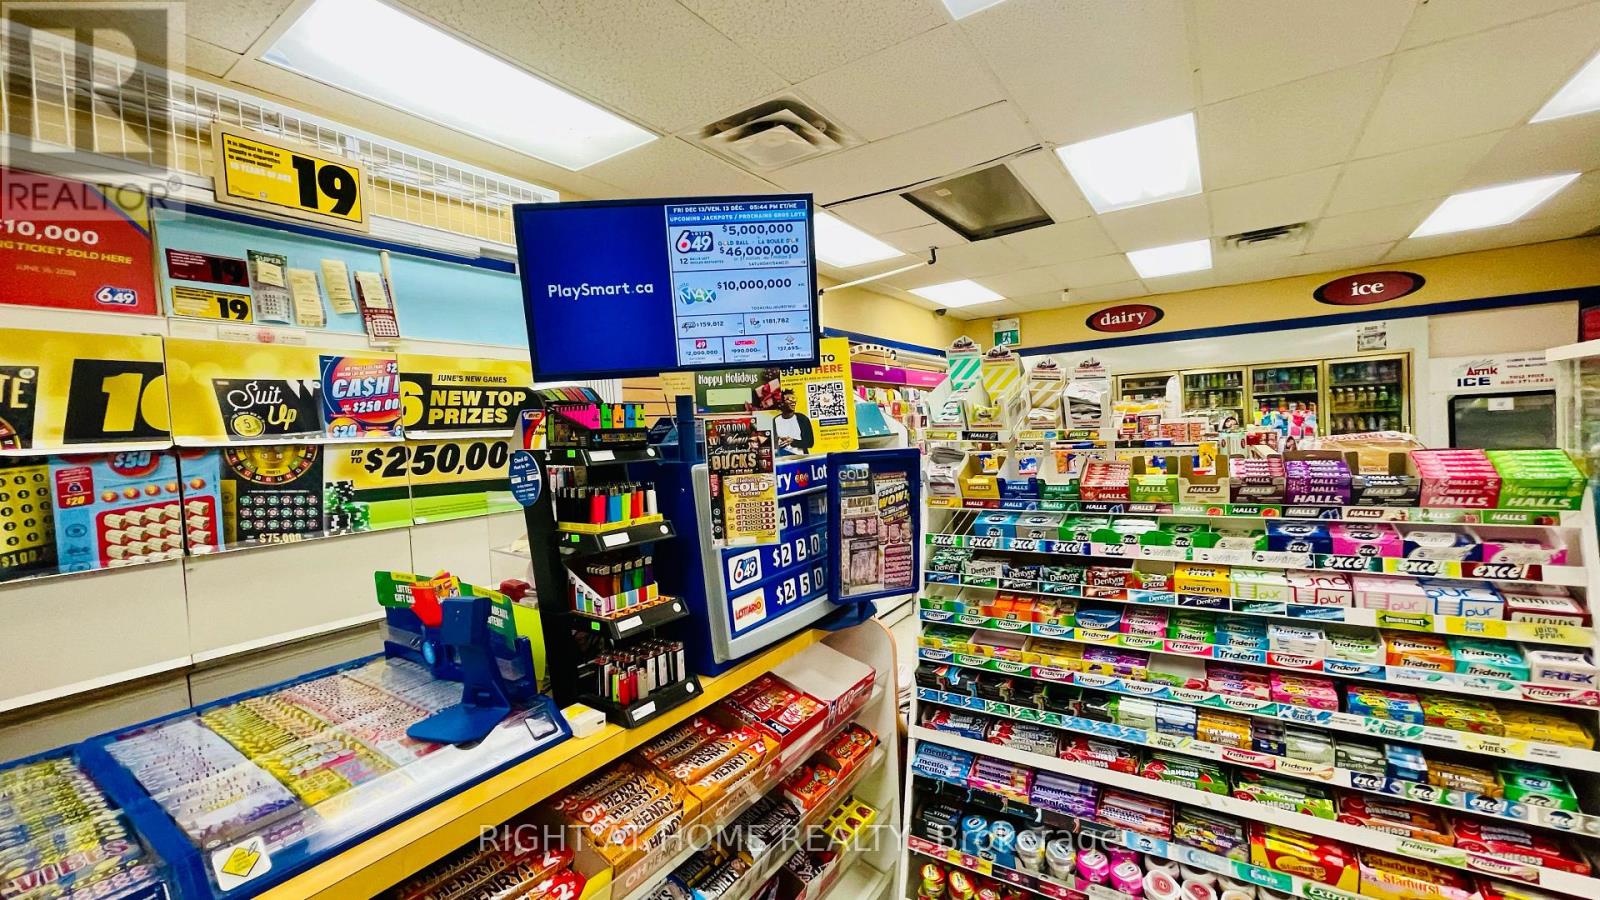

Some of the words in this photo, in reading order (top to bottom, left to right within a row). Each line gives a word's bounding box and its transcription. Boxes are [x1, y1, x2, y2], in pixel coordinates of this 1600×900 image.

[292, 154, 357, 216] 19
[722, 223, 793, 236] $5,000,000
[16, 242, 67, 256] TICKET
[66, 248, 99, 260] SOLD
[101, 252, 133, 265] HERE
[720, 244, 799, 257] $46,000,000
[680, 257, 689, 265] 12
[547, 281, 654, 300] PlaySmart.ca
[717, 278, 792, 291] $10,000,000
[1351, 279, 1384, 297] ice
[217, 297, 249, 321] 19
[1100, 308, 1147, 328] dairy
[696, 340, 707, 349] 49
[821, 354, 835, 363] TO
[815, 363, 844, 375] HERE
[437, 374, 463, 383] JUNE'S
[464, 375, 482, 383] NEW
[698, 374, 723, 388] Happy
[725, 372, 759, 386] Holidays
[1457, 376, 1491, 387] ICE
[331, 375, 388, 400] CA$H
[227, 380, 282, 411] Suit
[429, 390, 485, 406] NEW
[485, 391, 526, 406] TOP
[267, 405, 298, 431] Up
[428, 408, 508, 425] PRIZES
[351, 449, 363, 457] UP
[712, 453, 757, 470] BUCKS
[839, 468, 869, 480] GOLD
[729, 482, 769, 493] GOLD
[66, 495, 85, 505] $20
[879, 491, 909, 509] WOW!
[1293, 495, 1344, 504] HALLS
[1427, 496, 1489, 507] HALLS
[1506, 497, 1572, 509] HALLS
[1350, 509, 1381, 517] HALLS
[1491, 513, 1527, 521] HALLS
[259, 533, 302, 545] $75,000
[932, 534, 957, 546] excel
[969, 535, 998, 548] excel
[1010, 538, 1040, 551] excel
[1053, 541, 1087, 554] excel
[1323, 555, 1371, 570] excel
[970, 566, 996, 576] Dentyne
[1009, 569, 1037, 580] Dentyne
[1473, 563, 1530, 580] excel
[1050, 572, 1080, 583] Dentyne
[1094, 575, 1125, 587] Dentyne
[1142, 580, 1165, 590] Extra
[1319, 595, 1345, 606] pur
[925, 610, 948, 620] Trident
[1465, 606, 1495, 617] pur
[960, 615, 984, 625] Trident
[997, 620, 1022, 629] Trident
[1039, 625, 1065, 634] Trident
[1081, 630, 1110, 639] Trident
[1131, 627, 1157, 636] Trident
[1125, 635, 1155, 645] Trident
[1177, 632, 1206, 642] Trident
[1228, 638, 1259, 648] Trident
[1172, 642, 1204, 651] Trident
[924, 649, 947, 659] Trident
[960, 655, 984, 665] Trident
[1220, 649, 1260, 662] Trident
[997, 662, 1023, 671] Trident
[1275, 655, 1313, 666] Trident
[1402, 658, 1441, 670] Trident
[1039, 668, 1066, 679] Trident
[1329, 663, 1361, 673] Trident
[1468, 666, 1513, 680] Trident
[1078, 675, 1106, 685] Trident
[1124, 682, 1153, 693] Trident
[1528, 687, 1571, 698] Trident
[1172, 690, 1204, 701] Trident
[1224, 698, 1259, 710] Trident
[1479, 744, 1507, 754] VIBES
[1226, 750, 1256, 761] Trident
[713, 752, 754, 781] HENRY!
[916, 763, 947, 777] mentos
[918, 757, 949, 771] mentos
[1281, 760, 1313, 772] Trident
[582, 804, 604, 823] OH
[590, 818, 616, 836] OH
[1401, 839, 1438, 854] Trident
[1471, 857, 1512, 872] Trident
[1382, 873, 1442, 895] Starburst
